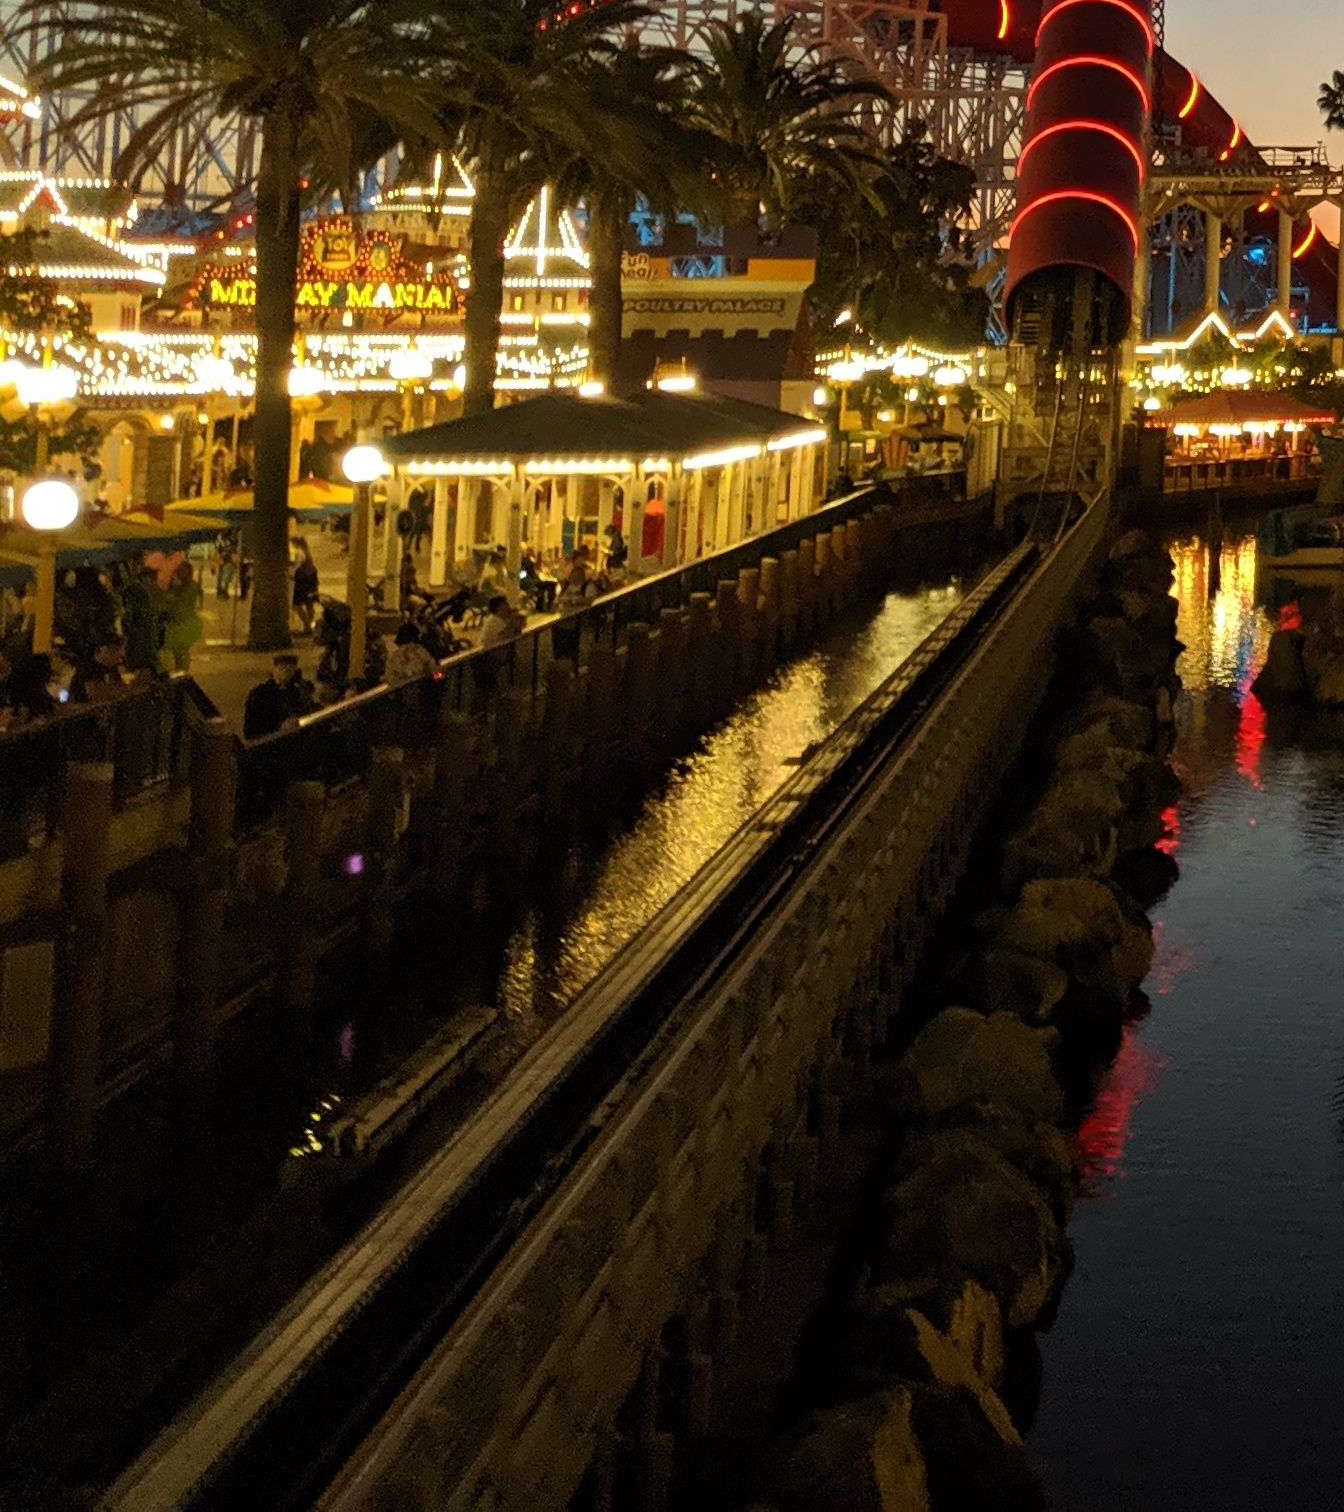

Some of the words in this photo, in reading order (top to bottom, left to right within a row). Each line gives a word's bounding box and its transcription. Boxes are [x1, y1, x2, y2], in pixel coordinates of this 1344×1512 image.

[211, 279, 337, 307] MIAY
[346, 282, 452, 309] MANIA!
[621, 298, 705, 313] POULTRY
[709, 298, 785, 313] PALACE
